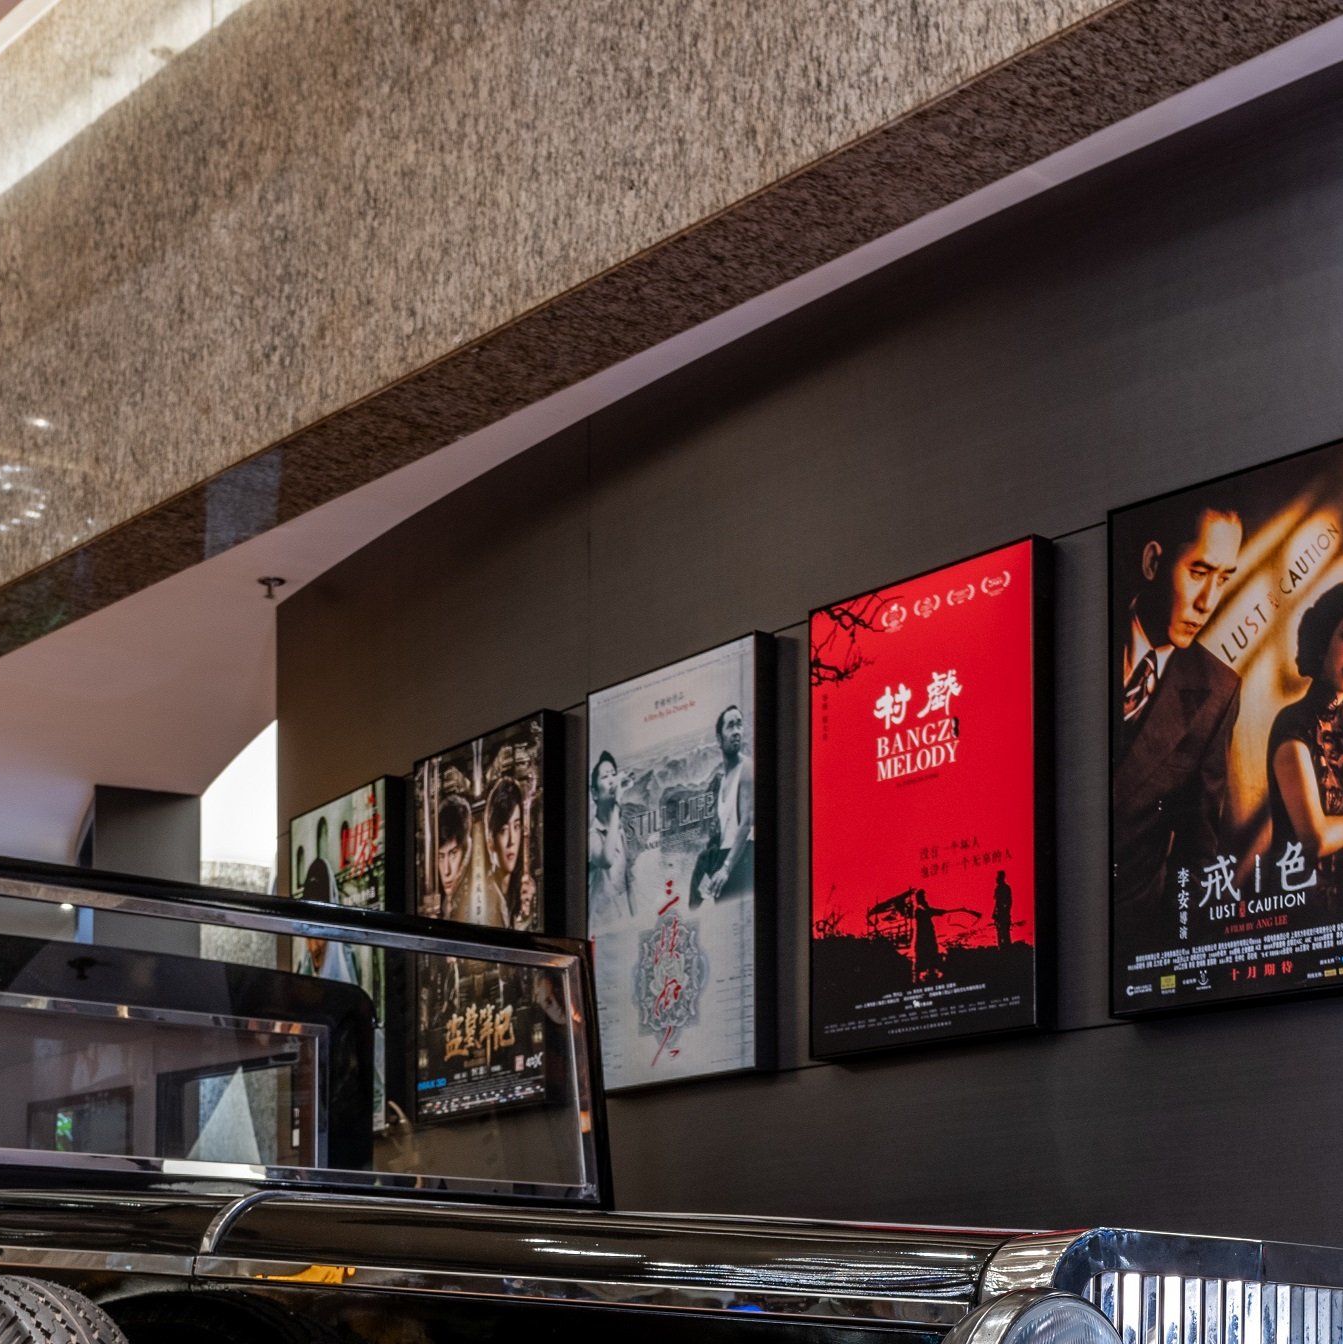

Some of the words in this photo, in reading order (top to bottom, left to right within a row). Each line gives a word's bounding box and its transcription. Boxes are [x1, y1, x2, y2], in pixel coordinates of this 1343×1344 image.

[1220, 603, 1268, 664] LUST
[1279, 522, 1340, 595] CAUTION
[876, 740, 960, 783] MELODY
[1209, 902, 1237, 921] LUST
[1248, 891, 1307, 913] CAUTION
[1256, 915, 1273, 930] ANG
[1274, 914, 1289, 926] LEE
